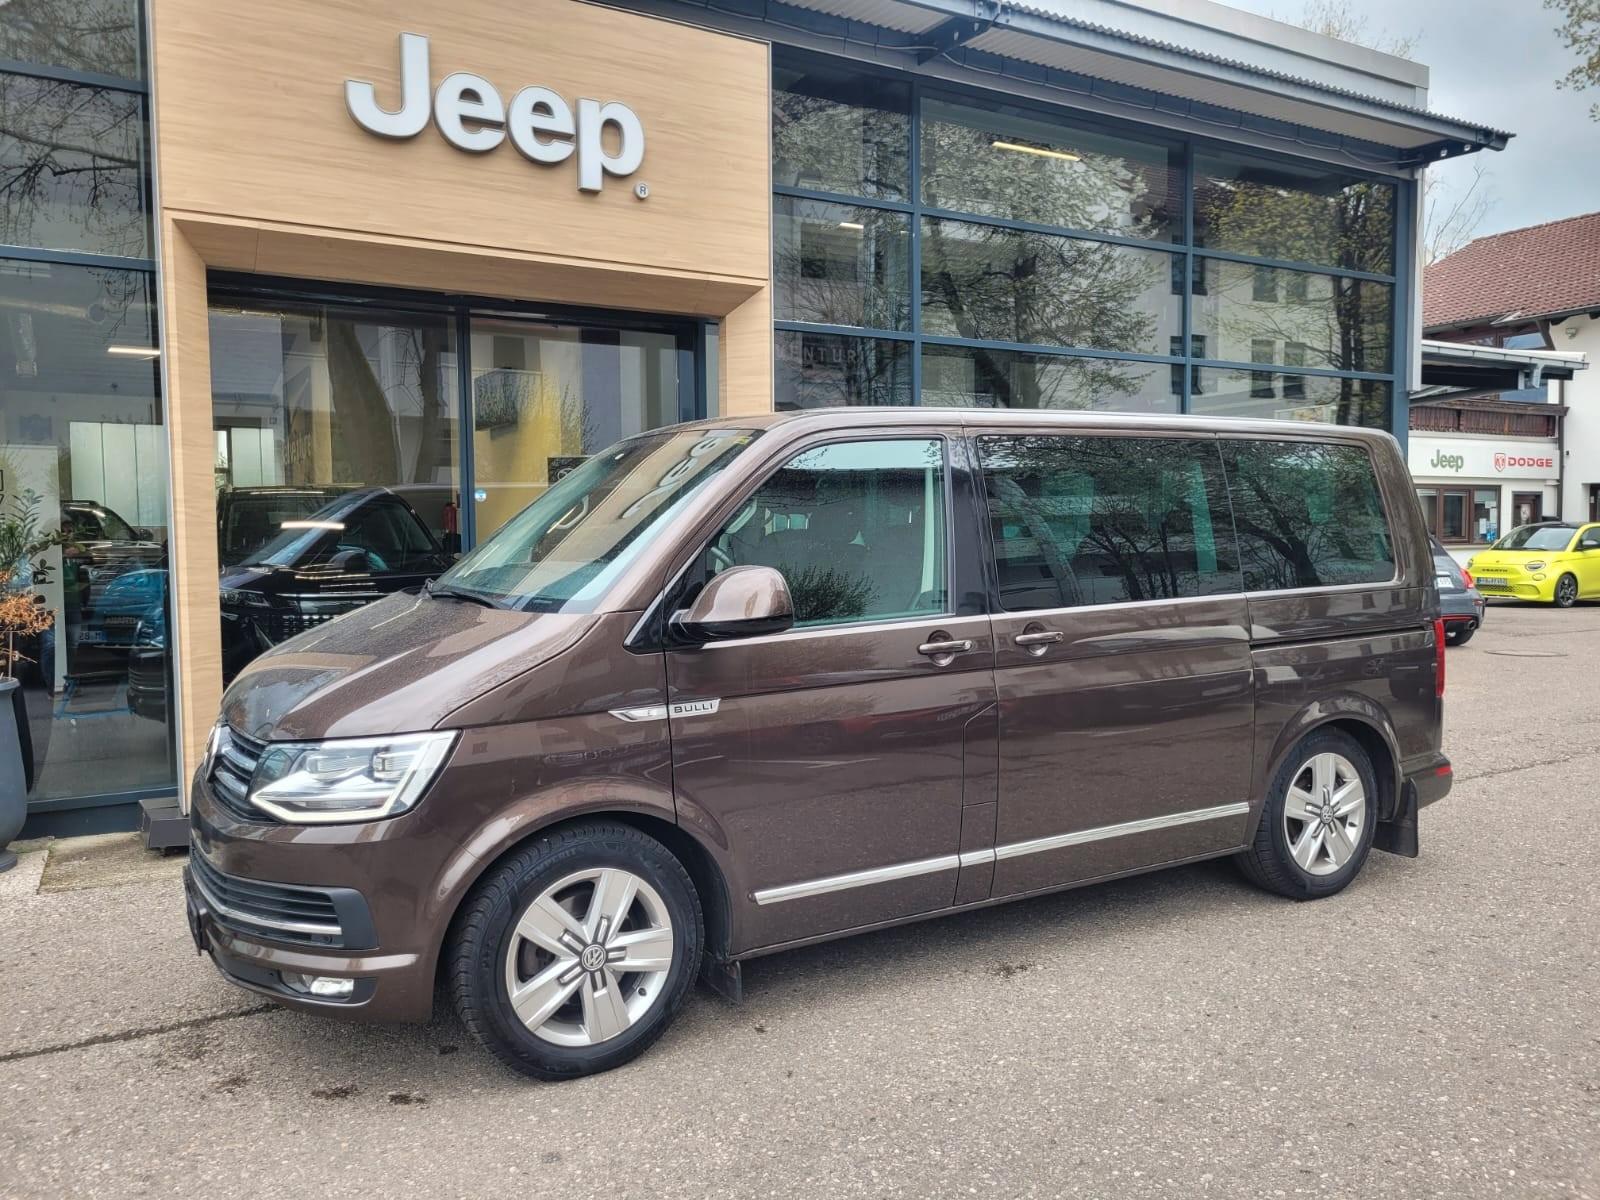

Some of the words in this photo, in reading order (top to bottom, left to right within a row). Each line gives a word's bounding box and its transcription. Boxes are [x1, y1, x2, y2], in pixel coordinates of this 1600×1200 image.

[344, 32, 645, 193] Jeep
[1430, 449, 1464, 472] Jeep
[1508, 456, 1553, 468] DODGE
[674, 702, 713, 714] BULLI
